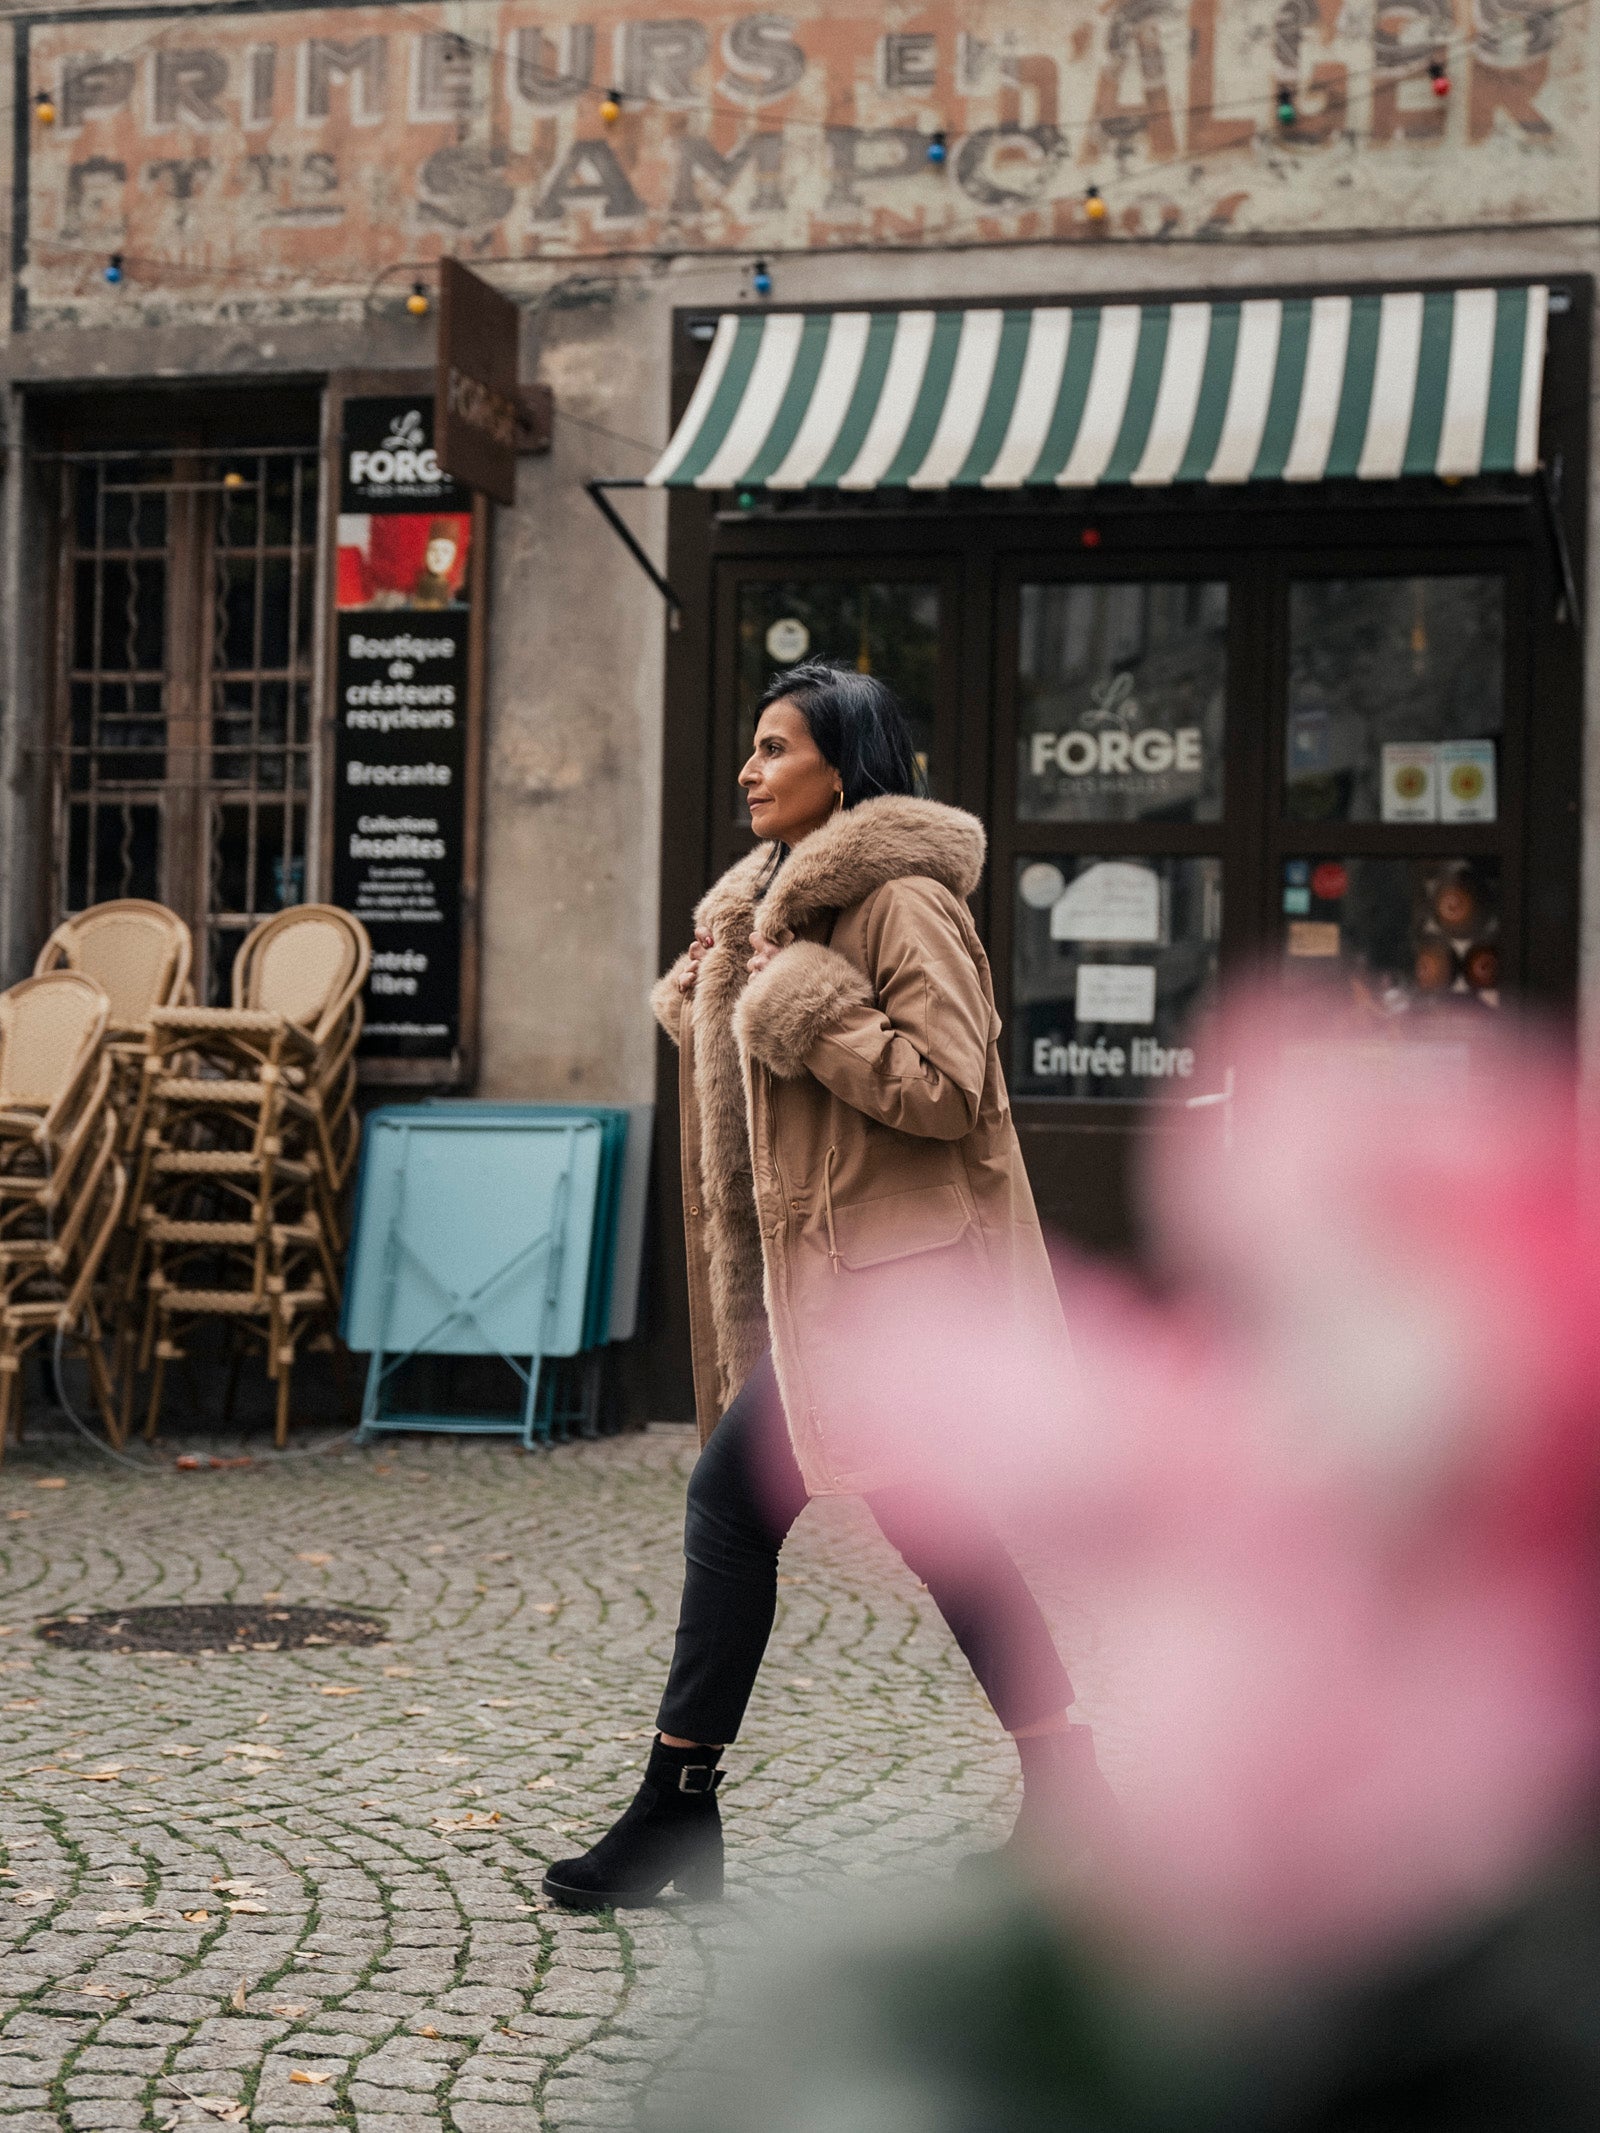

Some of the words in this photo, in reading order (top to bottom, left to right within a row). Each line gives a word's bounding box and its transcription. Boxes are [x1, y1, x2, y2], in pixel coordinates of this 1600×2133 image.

[55, 14, 808, 141] PRIMEURS
[349, 449, 453, 484] FORG
[348, 632, 456, 662] Boutique
[346, 679, 457, 706] créateurs
[1030, 727, 1202, 776] FORGE
[346, 760, 452, 786] Brocante
[370, 949, 428, 973] ntrée
[1033, 1036, 1126, 1077] Entrée
[1130, 1036, 1195, 1077] libre
